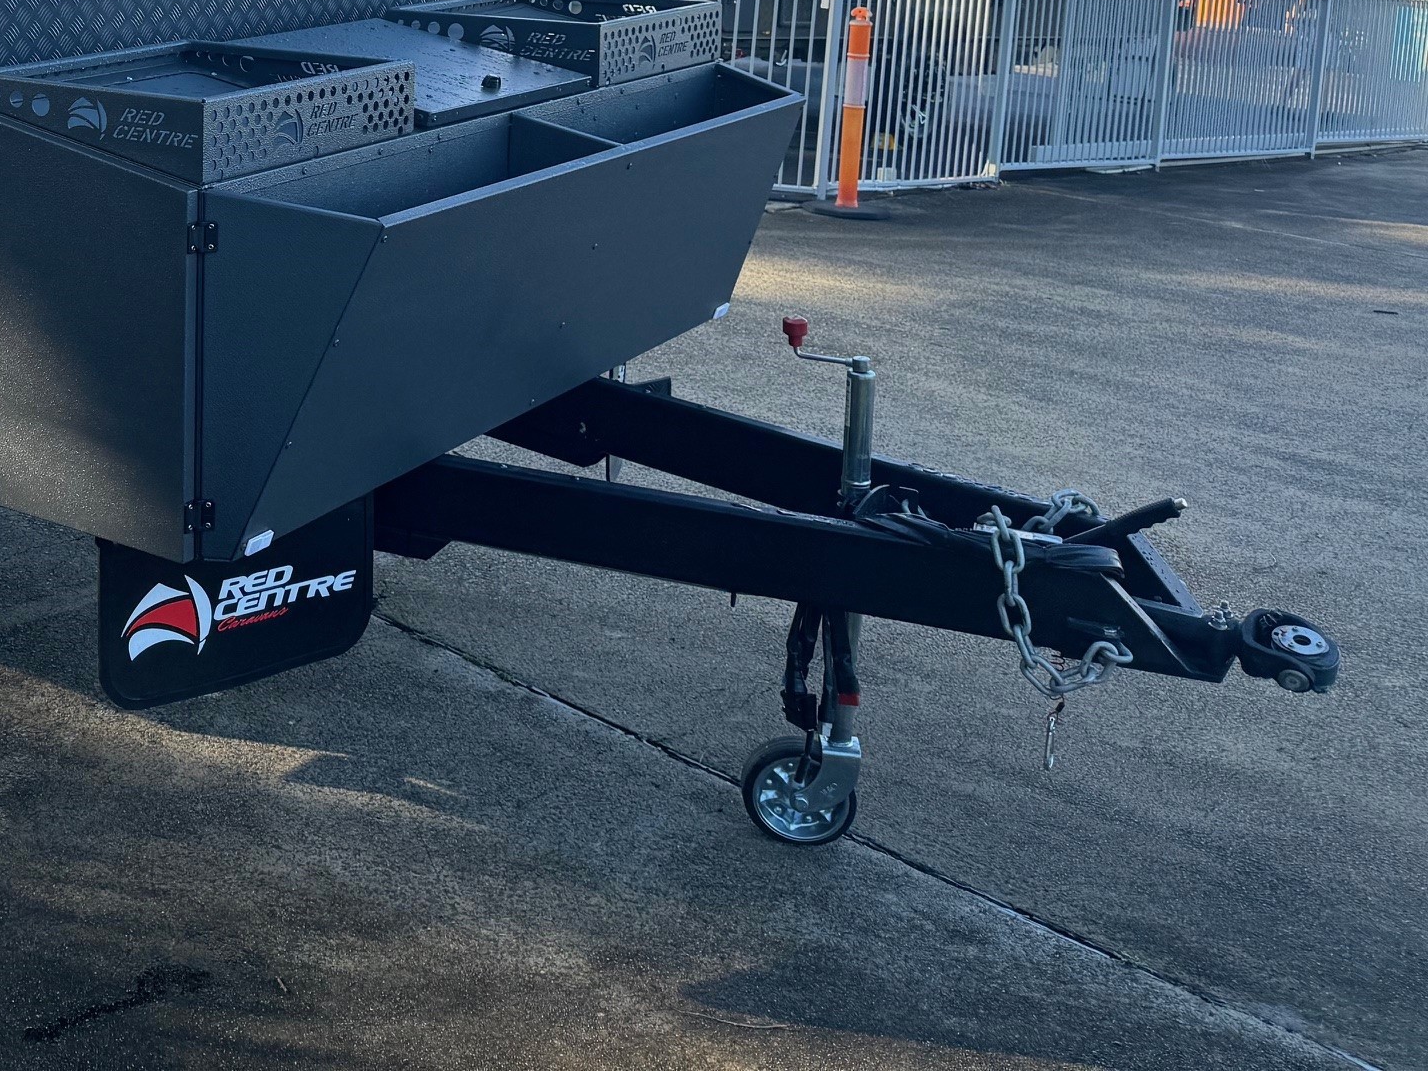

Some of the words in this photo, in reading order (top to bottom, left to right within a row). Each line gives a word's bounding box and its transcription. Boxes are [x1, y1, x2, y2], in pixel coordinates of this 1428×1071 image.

[527, 32, 566, 44] RED
[659, 31, 676, 44] RED
[519, 45, 596, 61] CENTRE
[658, 41, 689, 57] CENTRE
[121, 108, 165, 126] RED
[310, 102, 338, 119] RED
[307, 114, 359, 137] CENTRE
[113, 126, 199, 148] CENTRE
[218, 565, 293, 600] RED
[214, 570, 357, 621] CENTRE
[217, 607, 289, 632] Caravans
